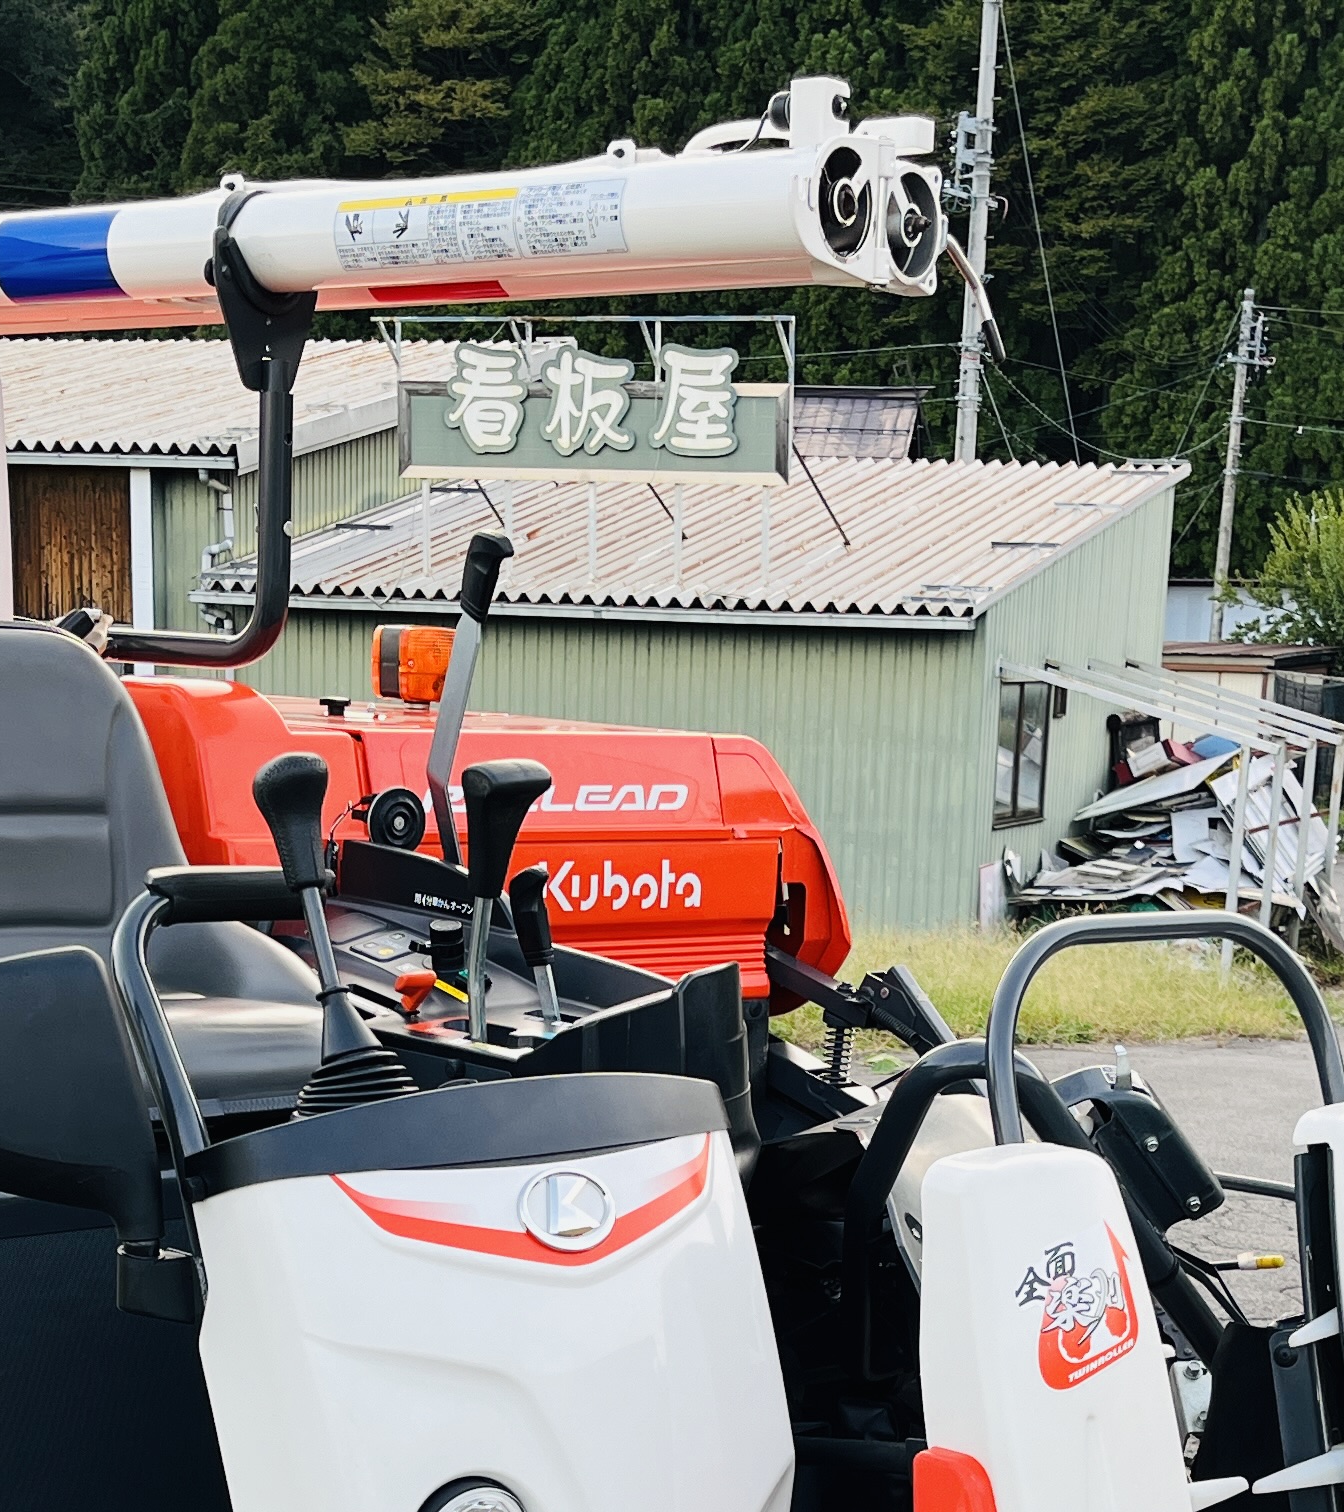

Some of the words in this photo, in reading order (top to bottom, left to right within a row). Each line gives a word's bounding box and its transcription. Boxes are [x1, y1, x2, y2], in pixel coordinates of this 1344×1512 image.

[449, 349, 734, 450] 看板屋
[422, 785, 689, 812] RLEAD
[539, 859, 702, 912] Kubota
